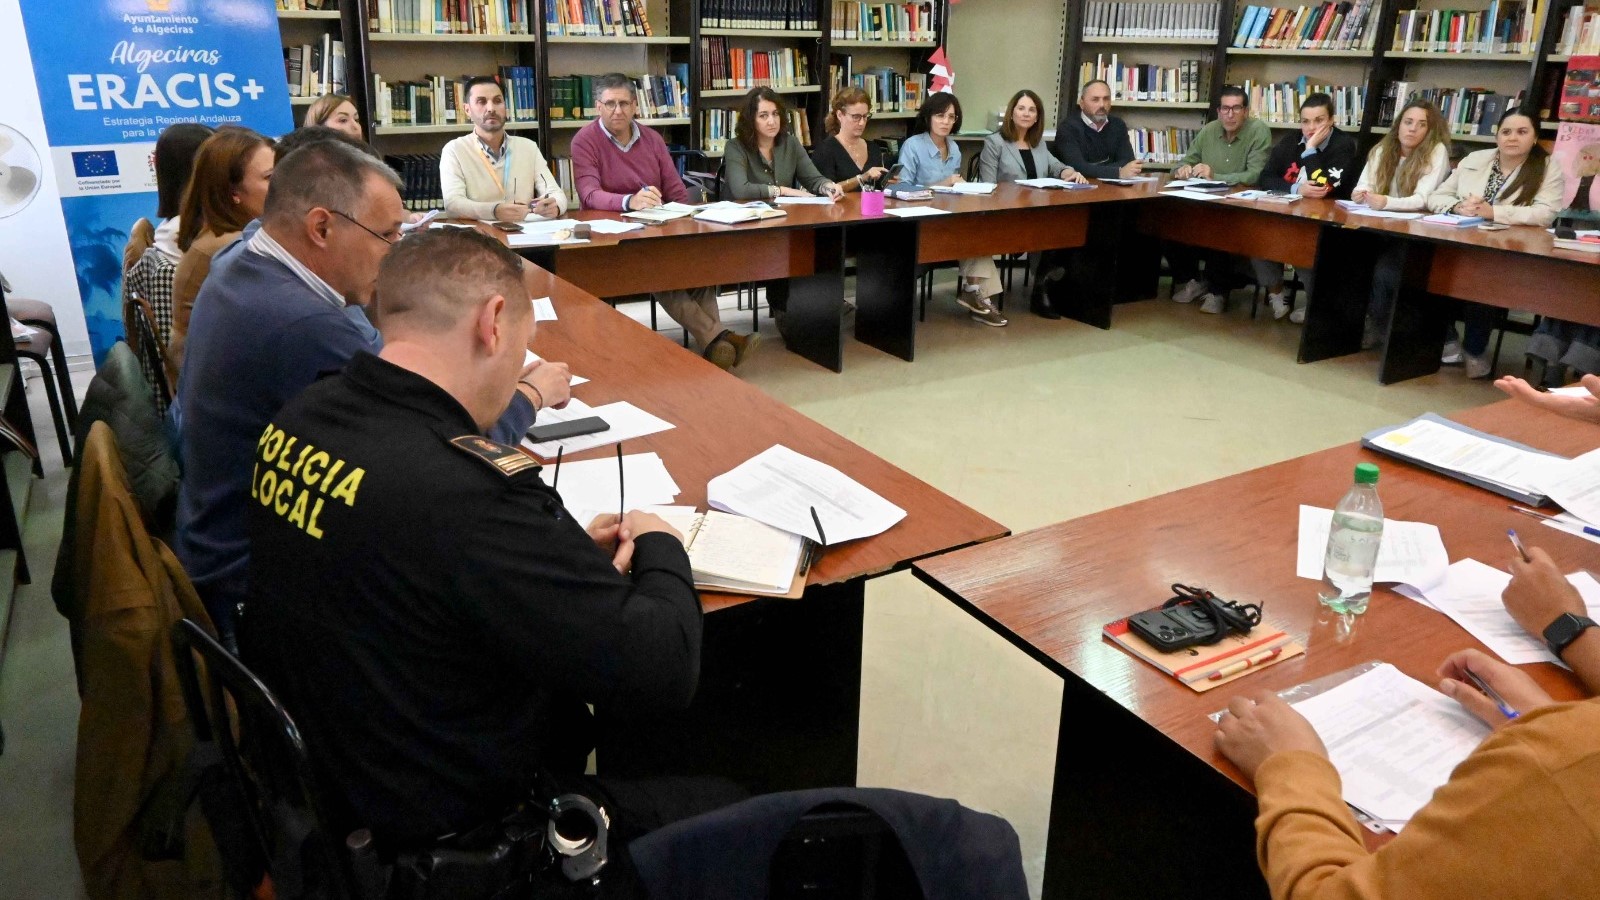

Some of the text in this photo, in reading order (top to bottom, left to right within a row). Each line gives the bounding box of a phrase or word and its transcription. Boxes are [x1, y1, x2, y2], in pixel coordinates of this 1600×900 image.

[123, 13, 199, 24] Ayuntamiento
[132, 24, 194, 34] de Algeciras
[110, 40, 221, 73] Algeciras
[67, 72, 264, 110] ERACIS+
[103, 113, 242, 127] Estrategia Regional Andaluza
[122, 129, 145, 140] para
[147, 127, 156, 137] la
[256, 423, 366, 507] POLICIA
[251, 462, 325, 540] LOCAL
